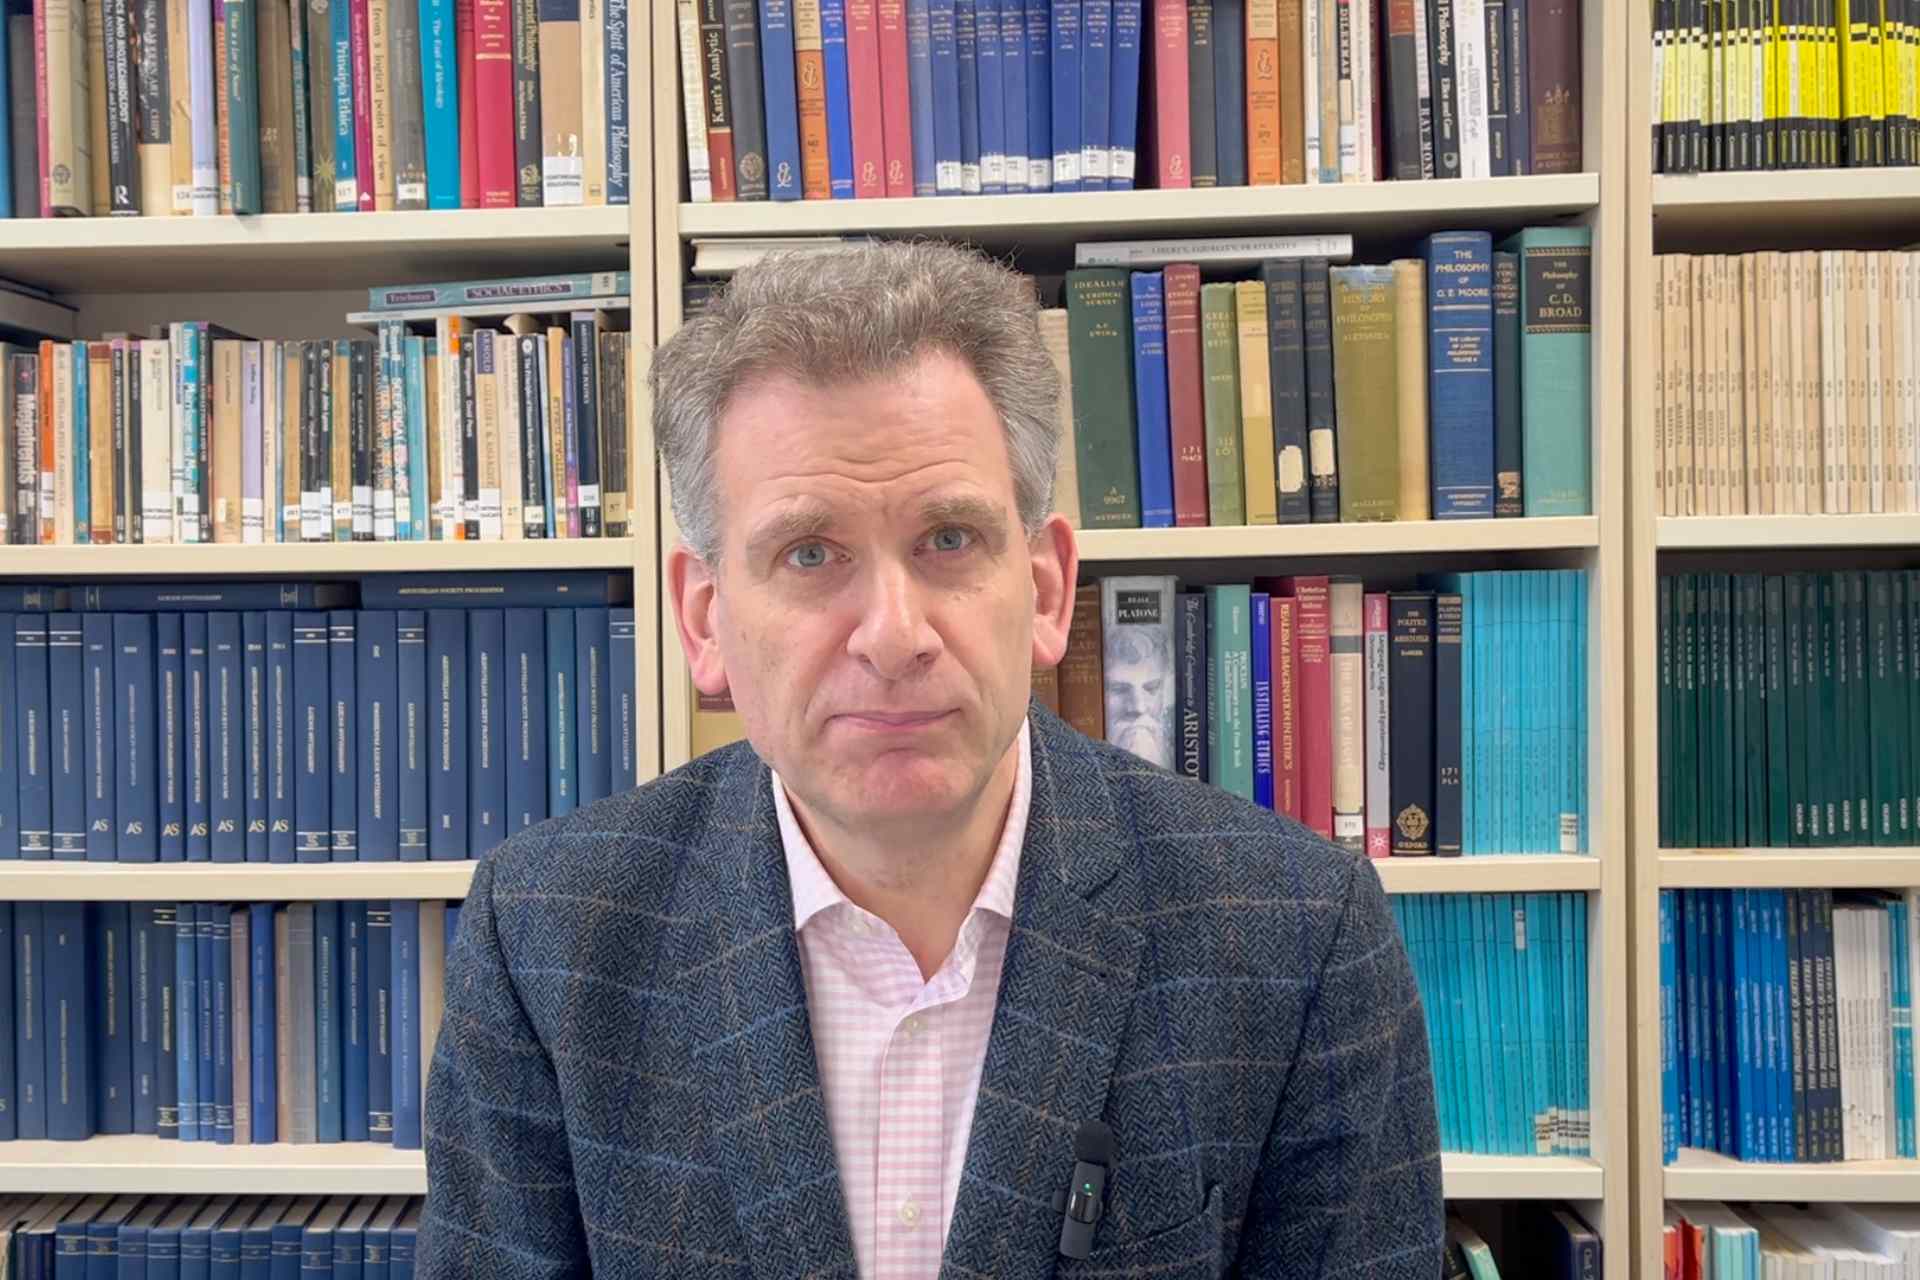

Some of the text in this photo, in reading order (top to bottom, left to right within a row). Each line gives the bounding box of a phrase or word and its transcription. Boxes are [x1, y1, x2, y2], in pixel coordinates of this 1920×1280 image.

[373, 8, 383, 36] from
[1340, 8, 1350, 74] DILEMMAS
[117, 17, 128, 123] AND BIOTECHNOLOGY
[1438, 7, 1451, 117] Philosophy and
[374, 55, 384, 93] logical
[706, 32, 725, 123] Kant's Analytic
[334, 40, 351, 136] Principia Ethica
[606, 0, 627, 187] The Spirit of American Philosophy
[374, 99, 385, 129] point
[1421, 108, 1430, 132] RAY
[377, 135, 386, 148] of
[378, 154, 386, 181] view
[1454, 250, 1473, 259] THE
[1435, 264, 1489, 273] PHILOSOPHY
[1458, 289, 1489, 297] MOORE
[1549, 294, 1575, 304] C. D.
[1539, 308, 1582, 318] BROAD
[482, 332, 491, 372] ARNOLD
[17, 393, 36, 484] Megatrends
[1118, 608, 1159, 618] PLATONE
[1186, 598, 1199, 612] The
[1279, 604, 1289, 646] REALISM
[1256, 681, 1270, 774] INSTILLING ETHICS
[92, 819, 109, 832] AS
[126, 821, 143, 834] AS
[162, 823, 180, 836] AS
[190, 823, 207, 836] AS
[217, 819, 234, 832] AS
[248, 819, 265, 834] AS
[272, 819, 289, 832] AS
